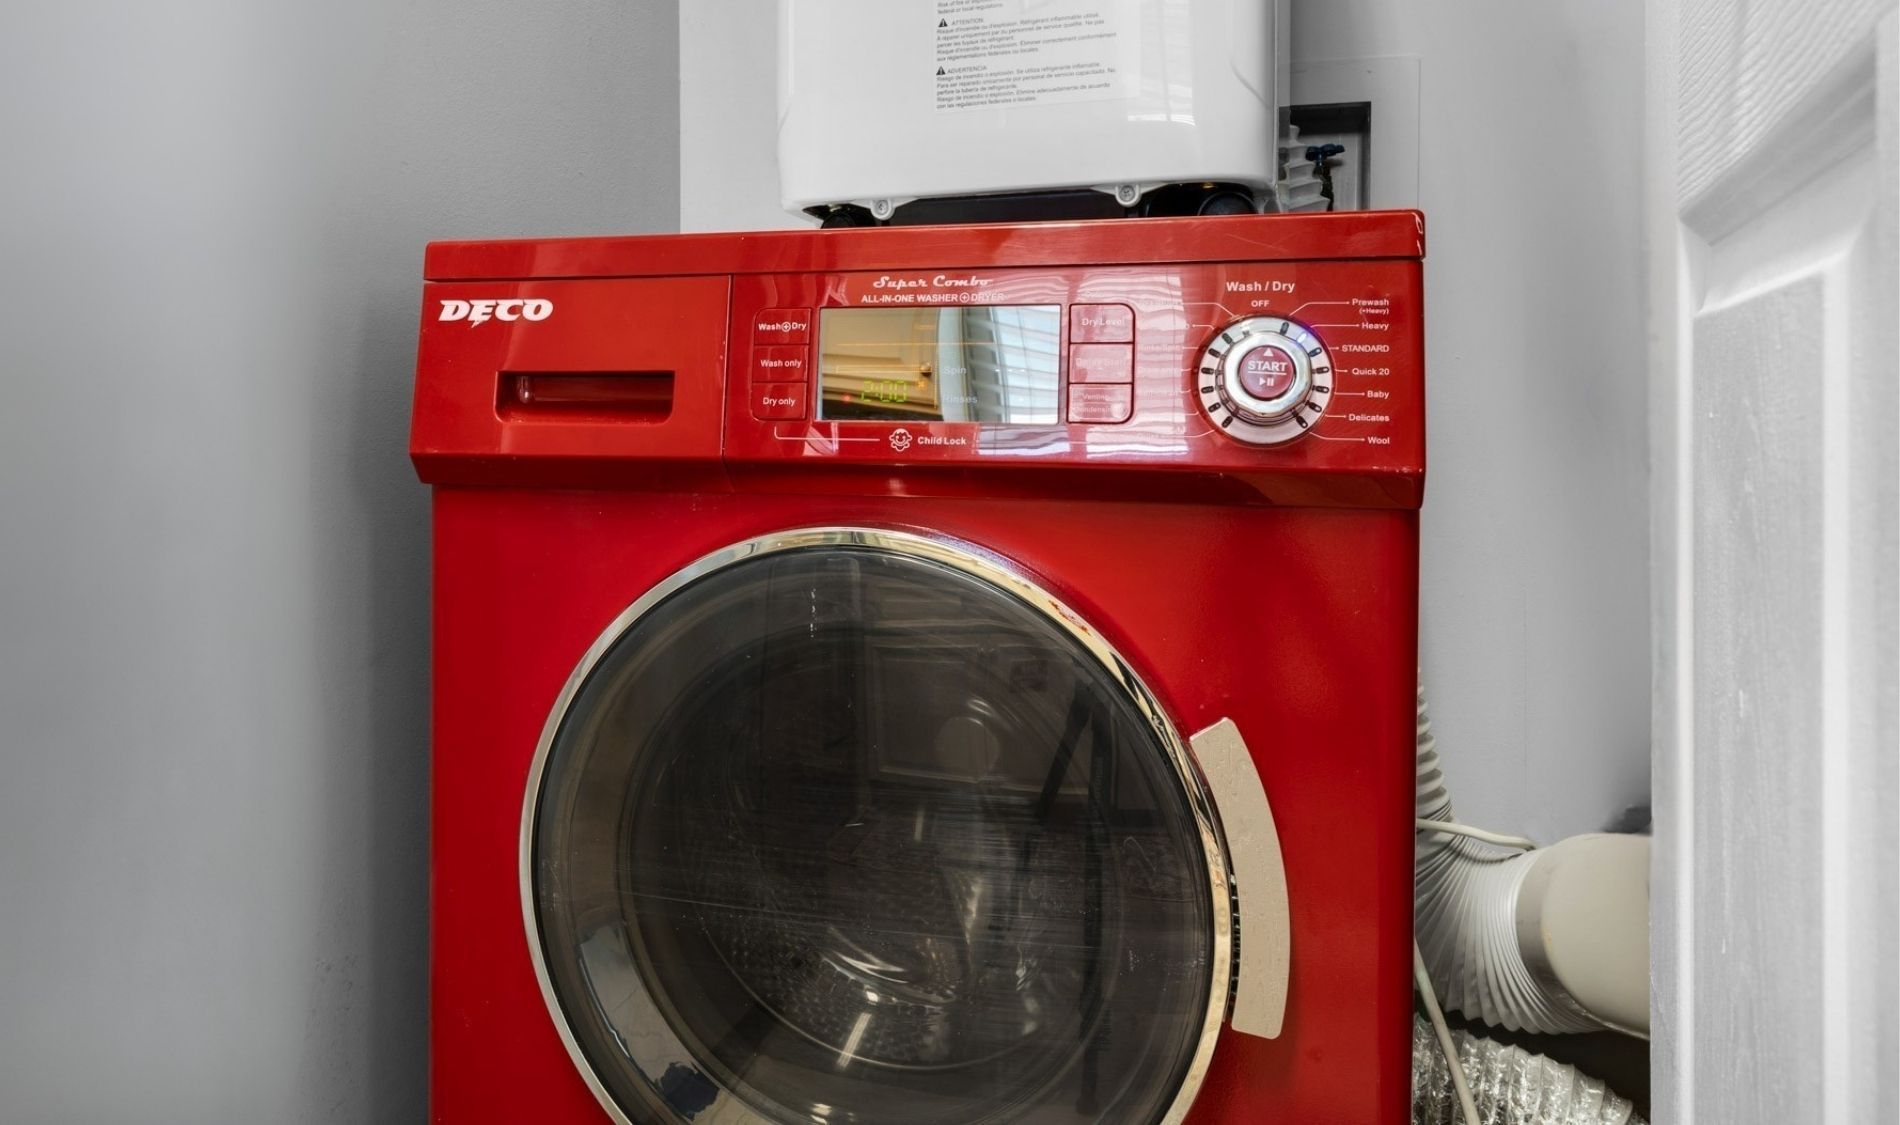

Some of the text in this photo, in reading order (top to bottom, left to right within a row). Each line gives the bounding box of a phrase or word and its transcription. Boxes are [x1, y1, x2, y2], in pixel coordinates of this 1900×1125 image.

[952, 18, 984, 26] ATTENTION
[873, 275, 993, 290] Super Combo
[1226, 282, 1262, 292] Wash
[1272, 281, 1295, 293] Dry
[861, 293, 1005, 303] ALL-IN-ONE WASHER DRYER
[1352, 298, 1389, 306] Prewash
[1251, 300, 1270, 308] OFF
[438, 298, 553, 328] DECO
[758, 322, 807, 333] Wash Dry
[1081, 318, 1125, 328] Dry Level
[1362, 322, 1389, 331] Heavy
[1341, 345, 1390, 353] STANDARD
[760, 359, 802, 369] Wash only
[1247, 361, 1288, 371] START
[942, 367, 967, 376] Spin
[1352, 367, 1390, 376] Quick 20
[943, 395, 978, 404] Rinses
[1367, 390, 1389, 400] Baby
[763, 397, 796, 407] Dry only
[1349, 413, 1390, 422] Delicates
[917, 435, 967, 446] Child Lock
[1368, 436, 1390, 444] Wool
